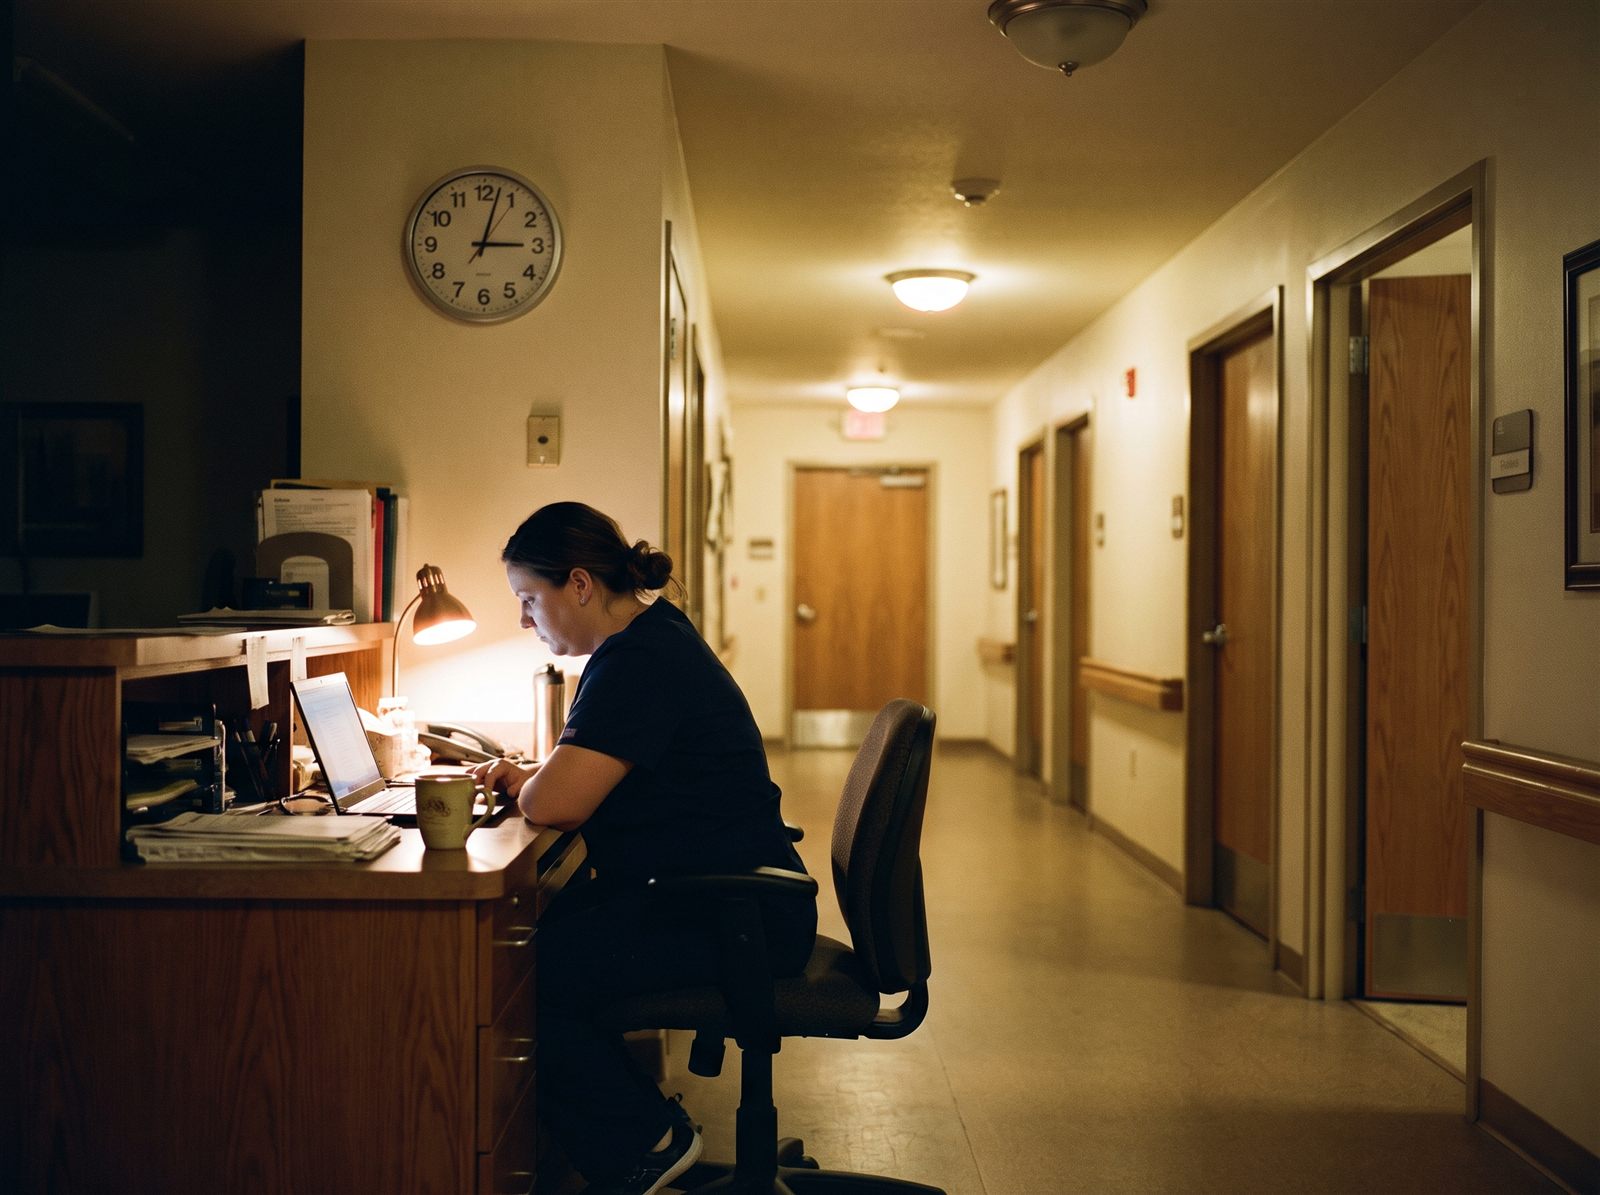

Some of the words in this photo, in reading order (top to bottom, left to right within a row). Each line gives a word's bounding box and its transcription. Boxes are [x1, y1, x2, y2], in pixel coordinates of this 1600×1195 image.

[451, 192, 465, 207] 11
[474, 185, 493, 201] 12
[507, 192, 514, 207] 1
[431, 211, 451, 227] 10
[525, 212, 536, 227] 2
[425, 237, 437, 252] 9
[532, 238, 544, 253] 3
[432, 263, 445, 279] 8
[523, 265, 536, 280] 4
[453, 282, 465, 297] 7
[478, 289, 490, 304] 6
[504, 283, 516, 298] 5
